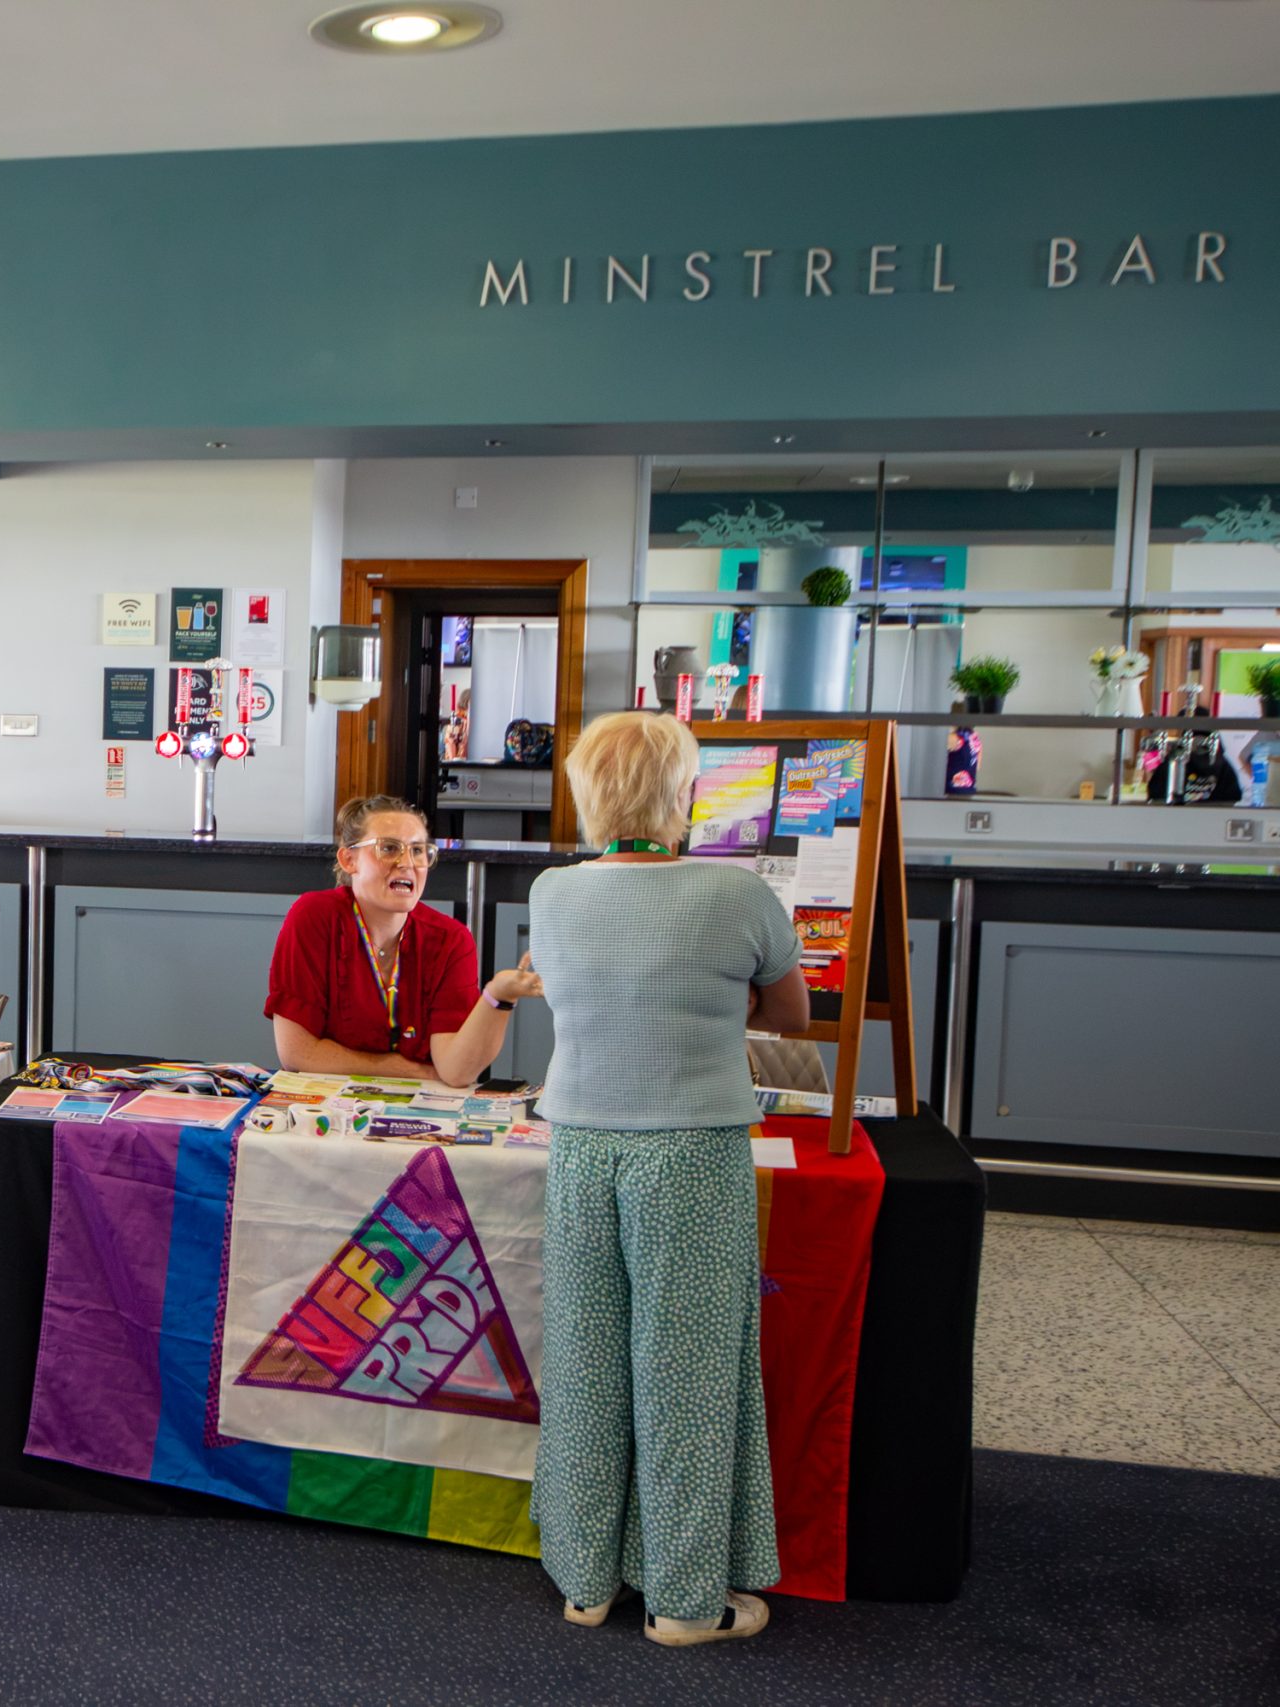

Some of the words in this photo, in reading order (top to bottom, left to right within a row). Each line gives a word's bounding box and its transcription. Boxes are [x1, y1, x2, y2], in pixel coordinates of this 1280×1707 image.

[479, 242, 956, 307] MINSTREL
[1047, 231, 1228, 289] BAR
[190, 697, 207, 705] ARD
[796, 920, 845, 940] SOUL
